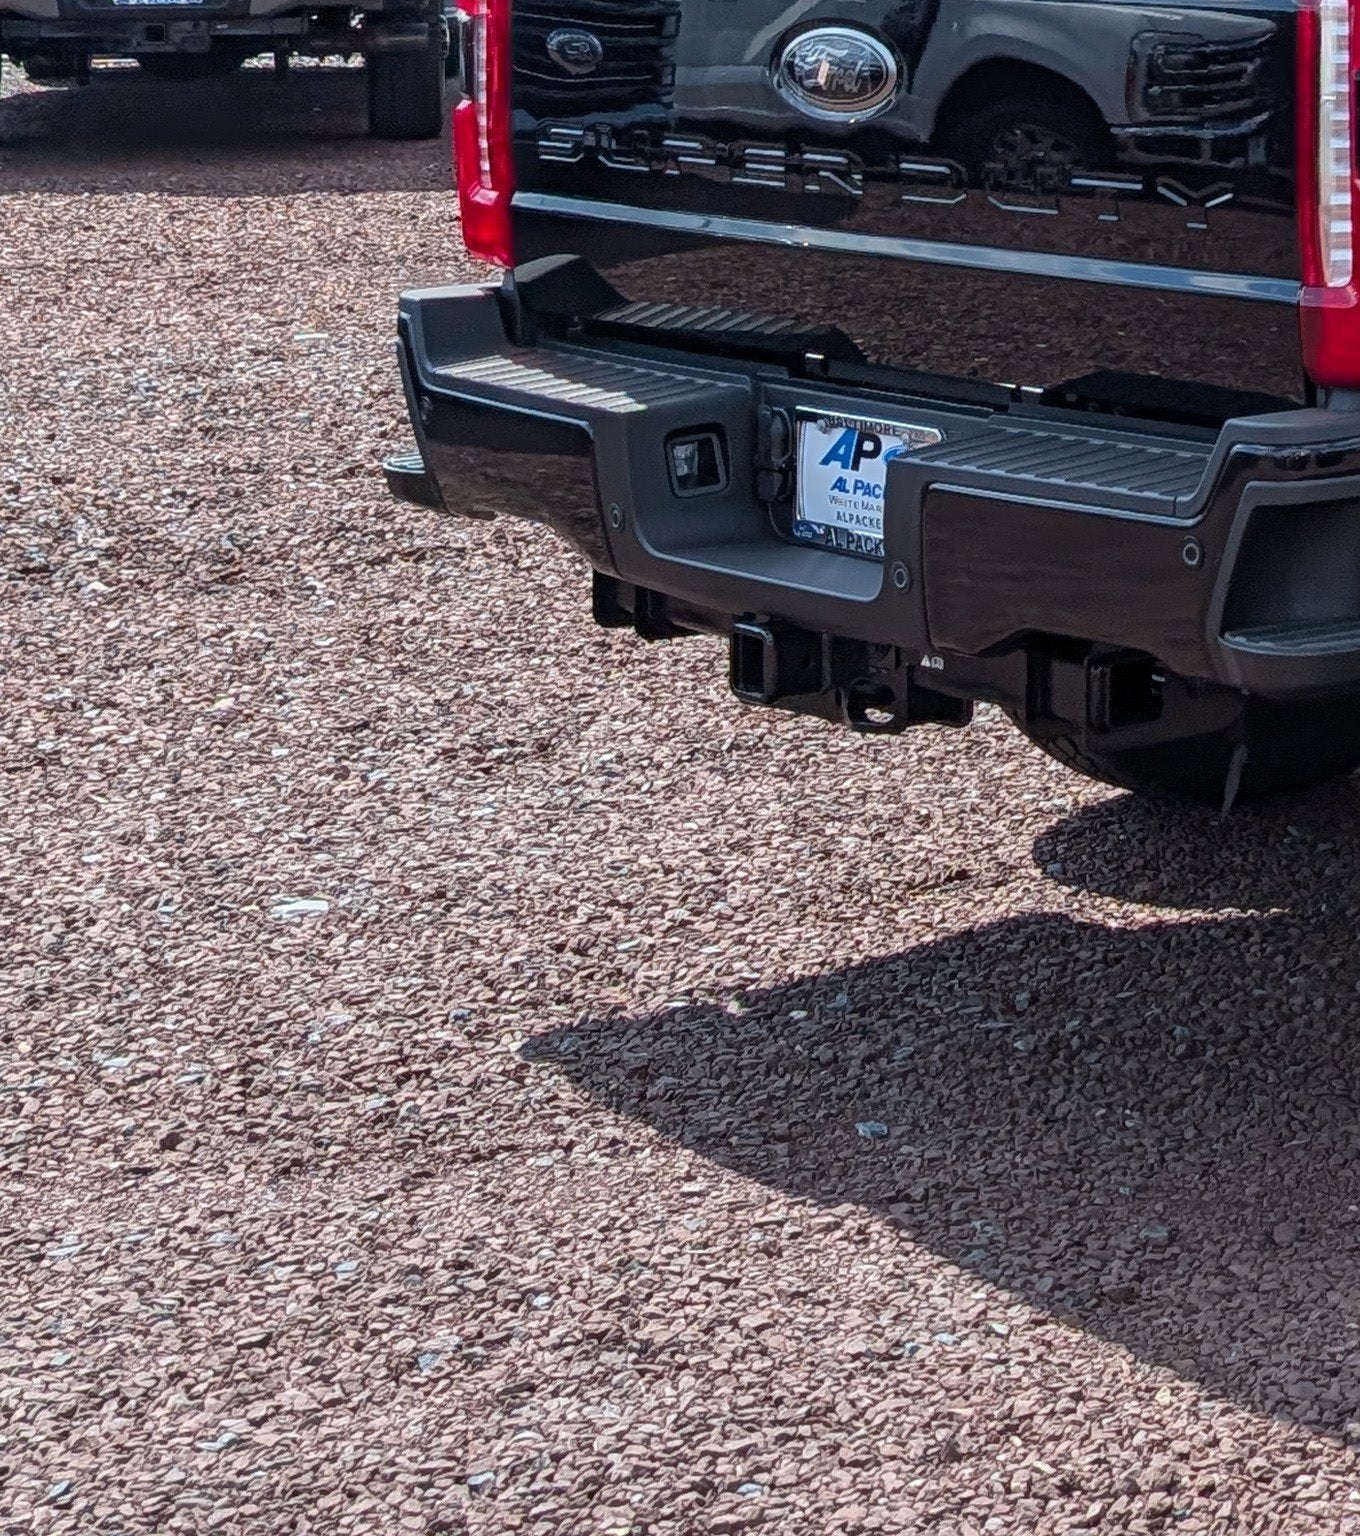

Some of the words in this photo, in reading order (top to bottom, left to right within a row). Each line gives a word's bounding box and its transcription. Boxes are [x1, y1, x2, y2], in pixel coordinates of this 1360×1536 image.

[796, 45, 864, 94] Ford
[538, 119, 864, 196] SUPER
[898, 154, 1235, 229] DUTY
[819, 427, 882, 471] AP
[830, 476, 850, 494] AL
[824, 527, 843, 547] AL
